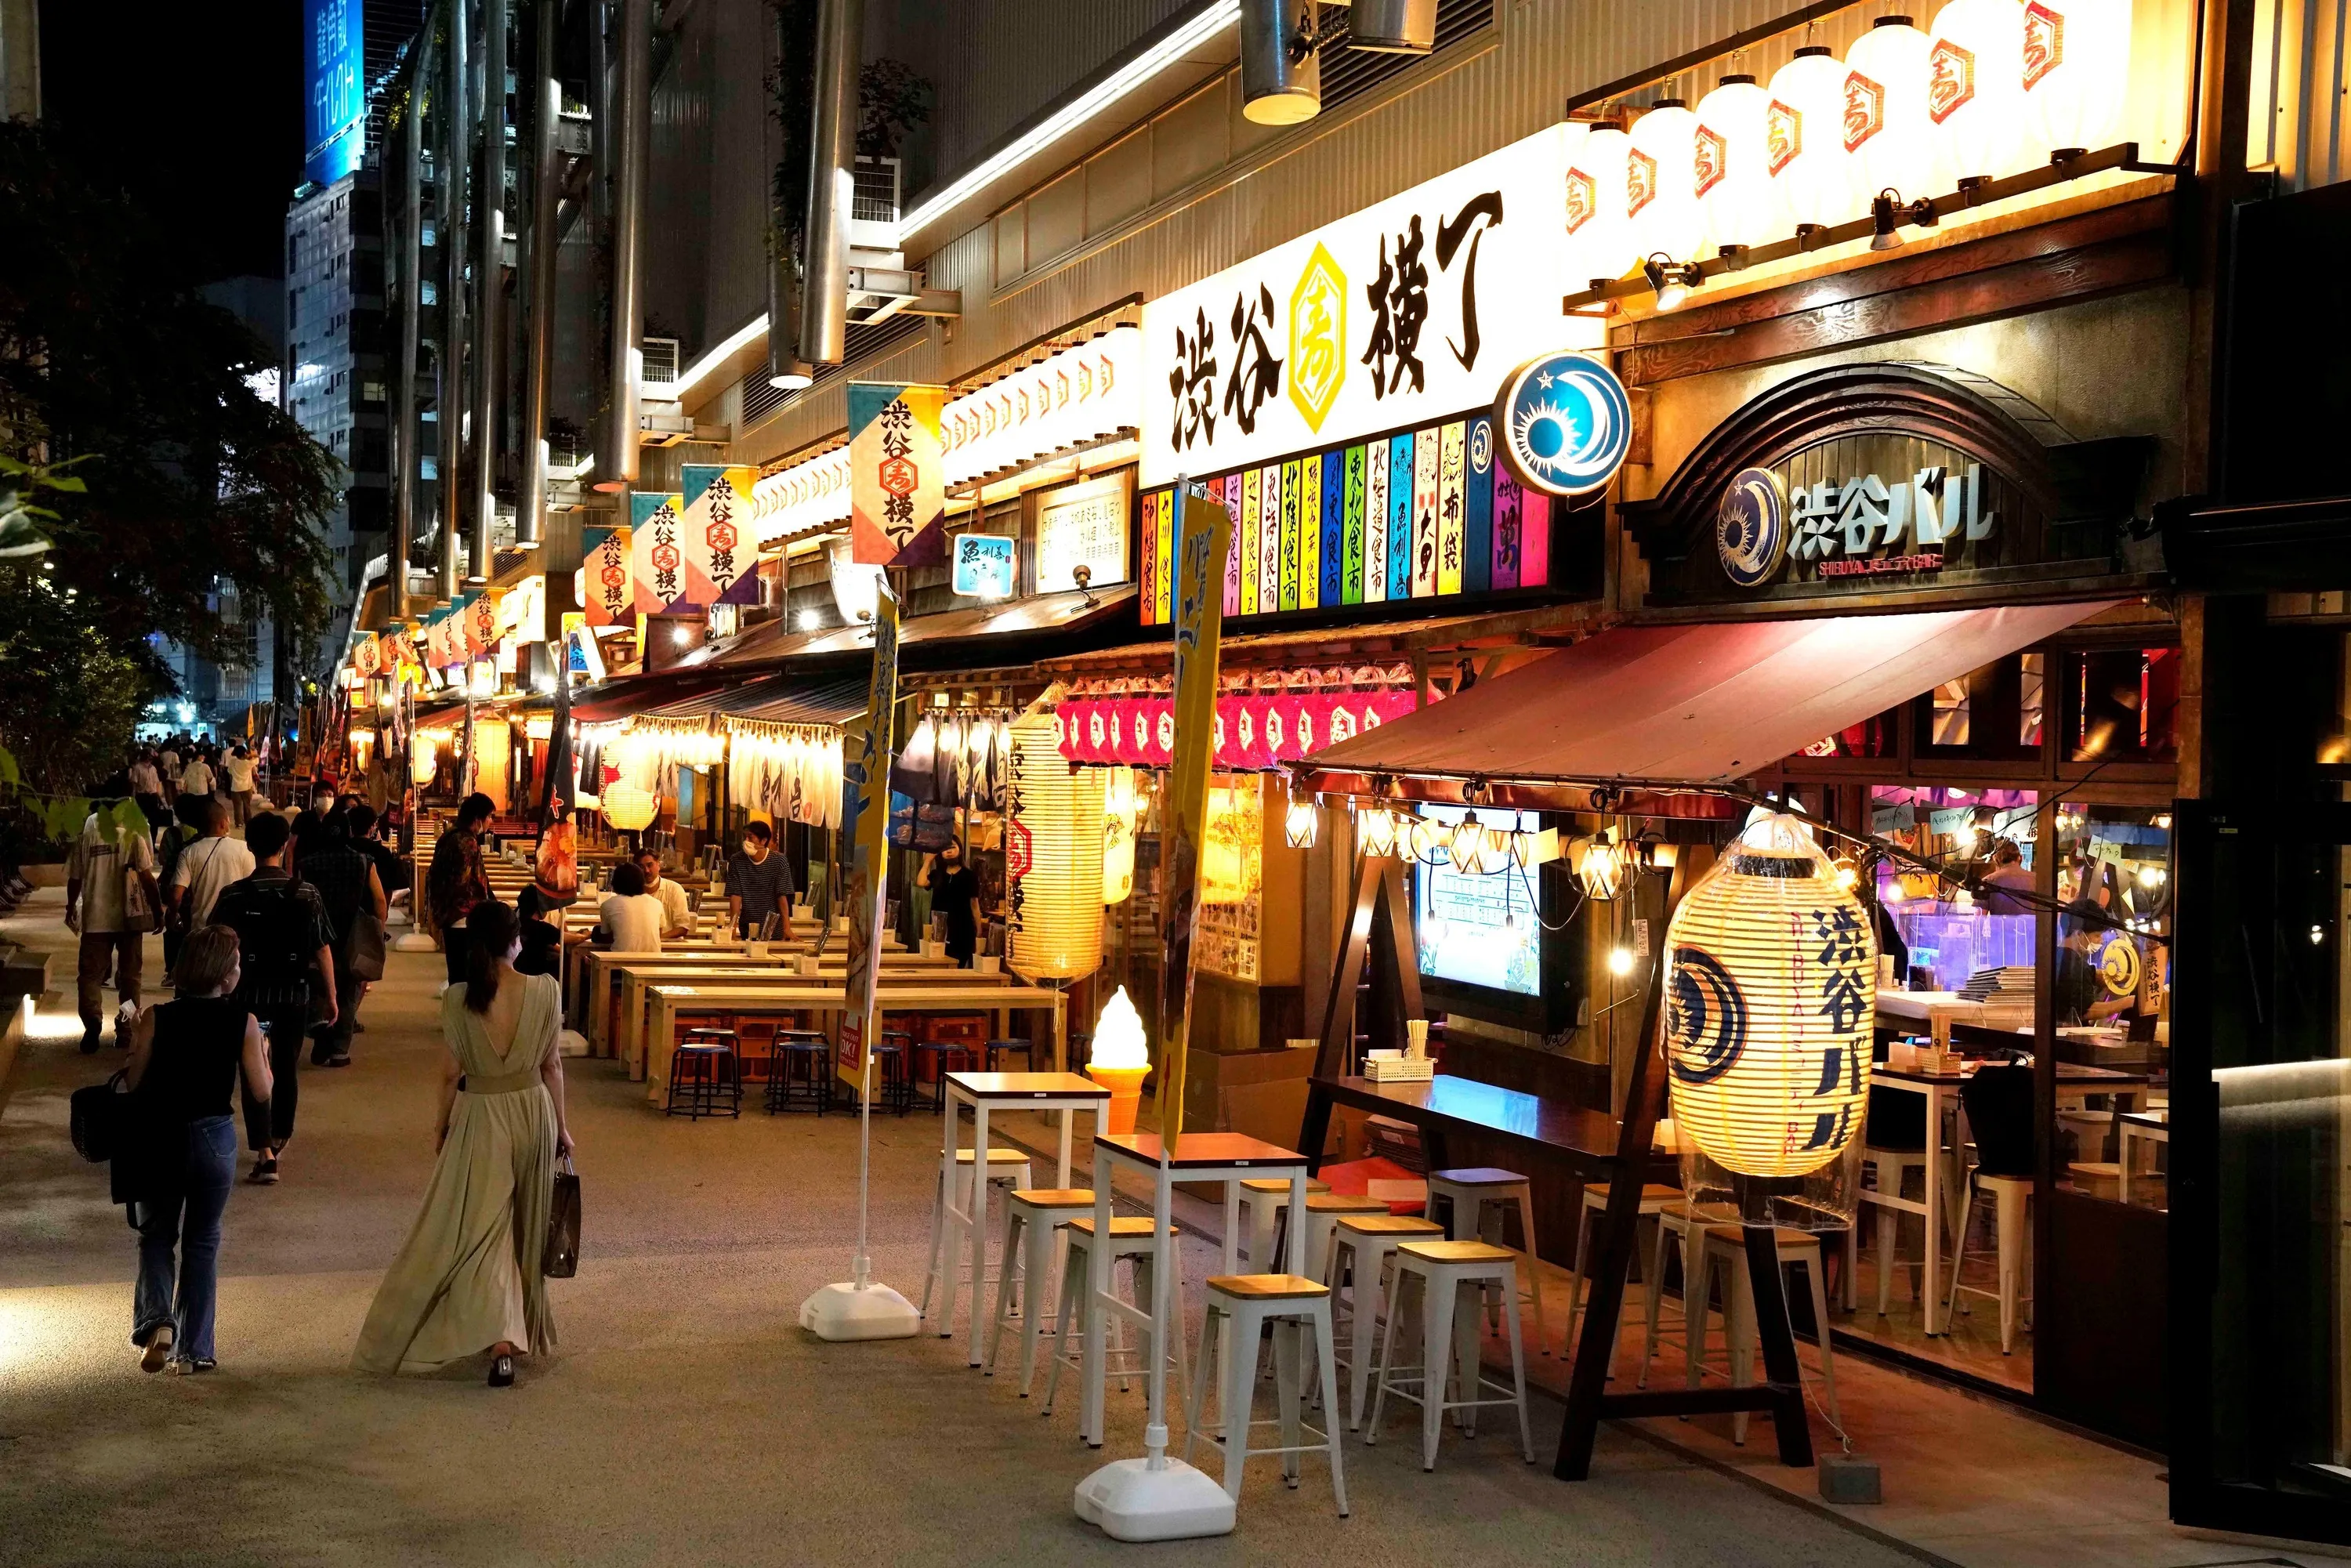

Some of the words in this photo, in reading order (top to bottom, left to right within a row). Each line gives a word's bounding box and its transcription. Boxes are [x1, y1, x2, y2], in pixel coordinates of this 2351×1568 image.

[1283, 464, 1298, 609] 北陸食市
[1787, 463, 1999, 560] 渋谷バル
[1802, 904, 1867, 1150] 渋谷バル
